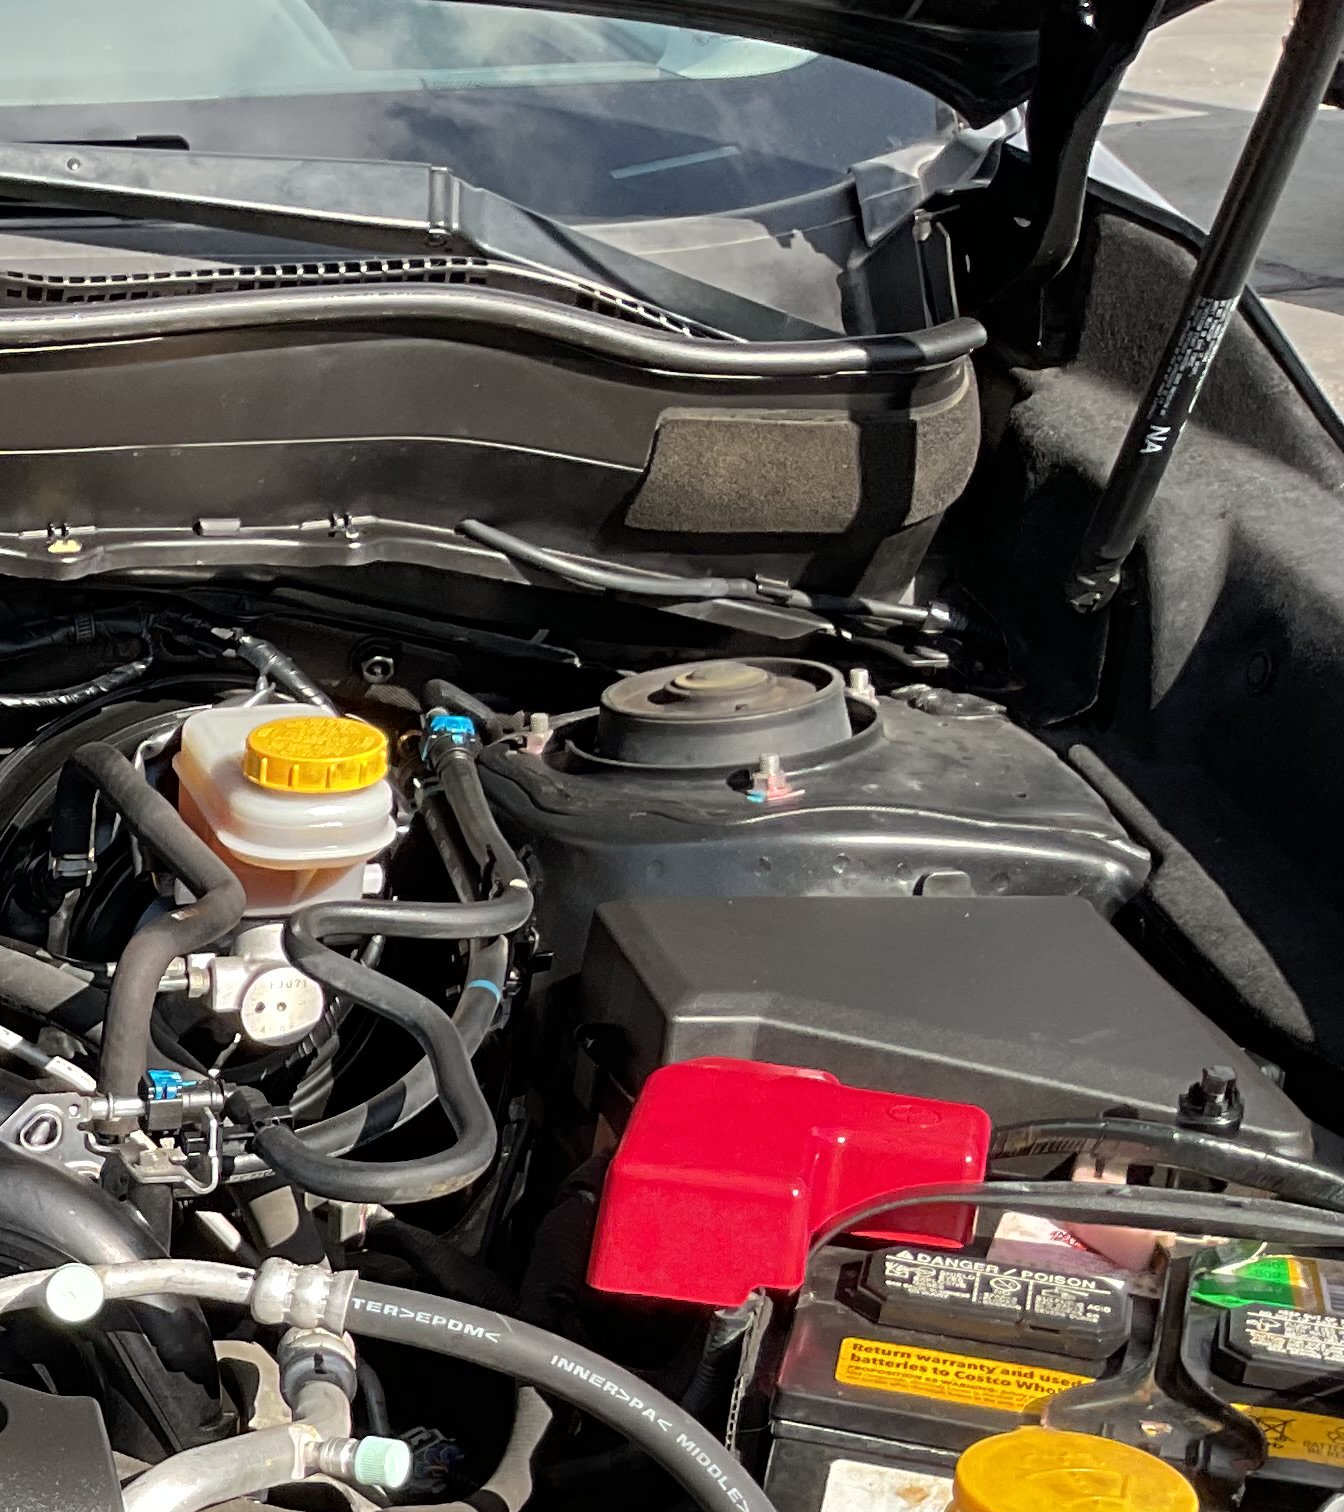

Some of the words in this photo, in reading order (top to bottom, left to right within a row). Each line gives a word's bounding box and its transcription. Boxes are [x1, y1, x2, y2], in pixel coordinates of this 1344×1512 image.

[917, 1253, 1000, 1275] DANGER
[1020, 1270, 1097, 1290] POISON
[850, 1353, 928, 1374] batteries
[932, 1366, 950, 1377] to
[955, 1370, 1012, 1388] Costco
[853, 1343, 912, 1359] Return
[916, 1353, 997, 1375] warranty
[1000, 1365, 1035, 1380] and
[1039, 1374, 1082, 1388] used
